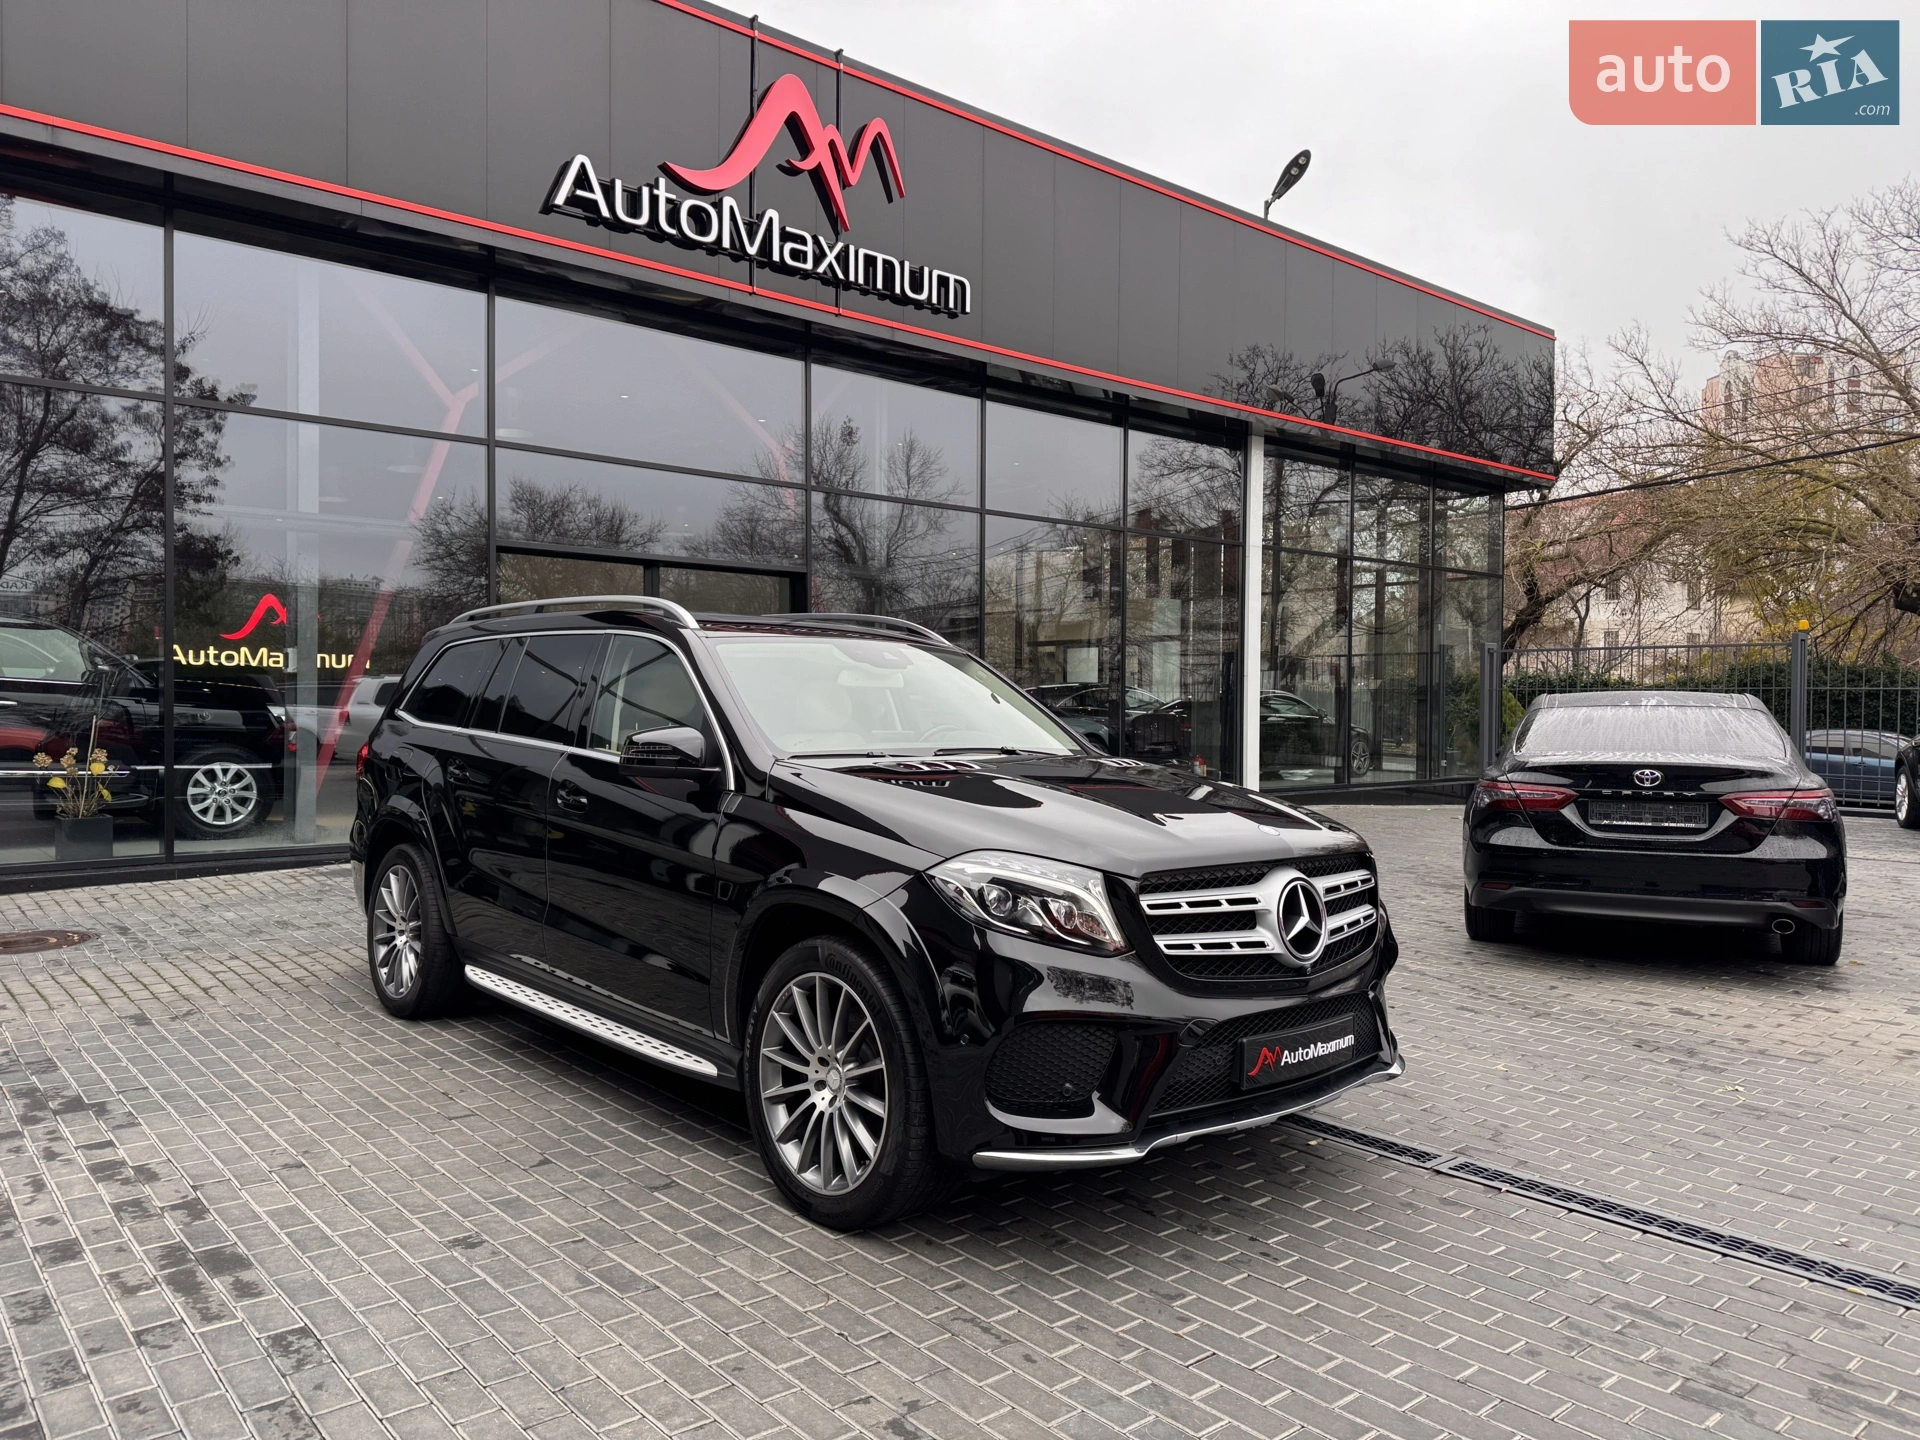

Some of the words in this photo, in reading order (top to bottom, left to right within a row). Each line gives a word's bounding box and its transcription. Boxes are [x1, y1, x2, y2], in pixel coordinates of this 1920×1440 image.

[550, 154, 972, 315] AutoMaximum
[172, 643, 371, 669] AutoMamum
[1280, 1034, 1355, 1067] AutoMaximum
